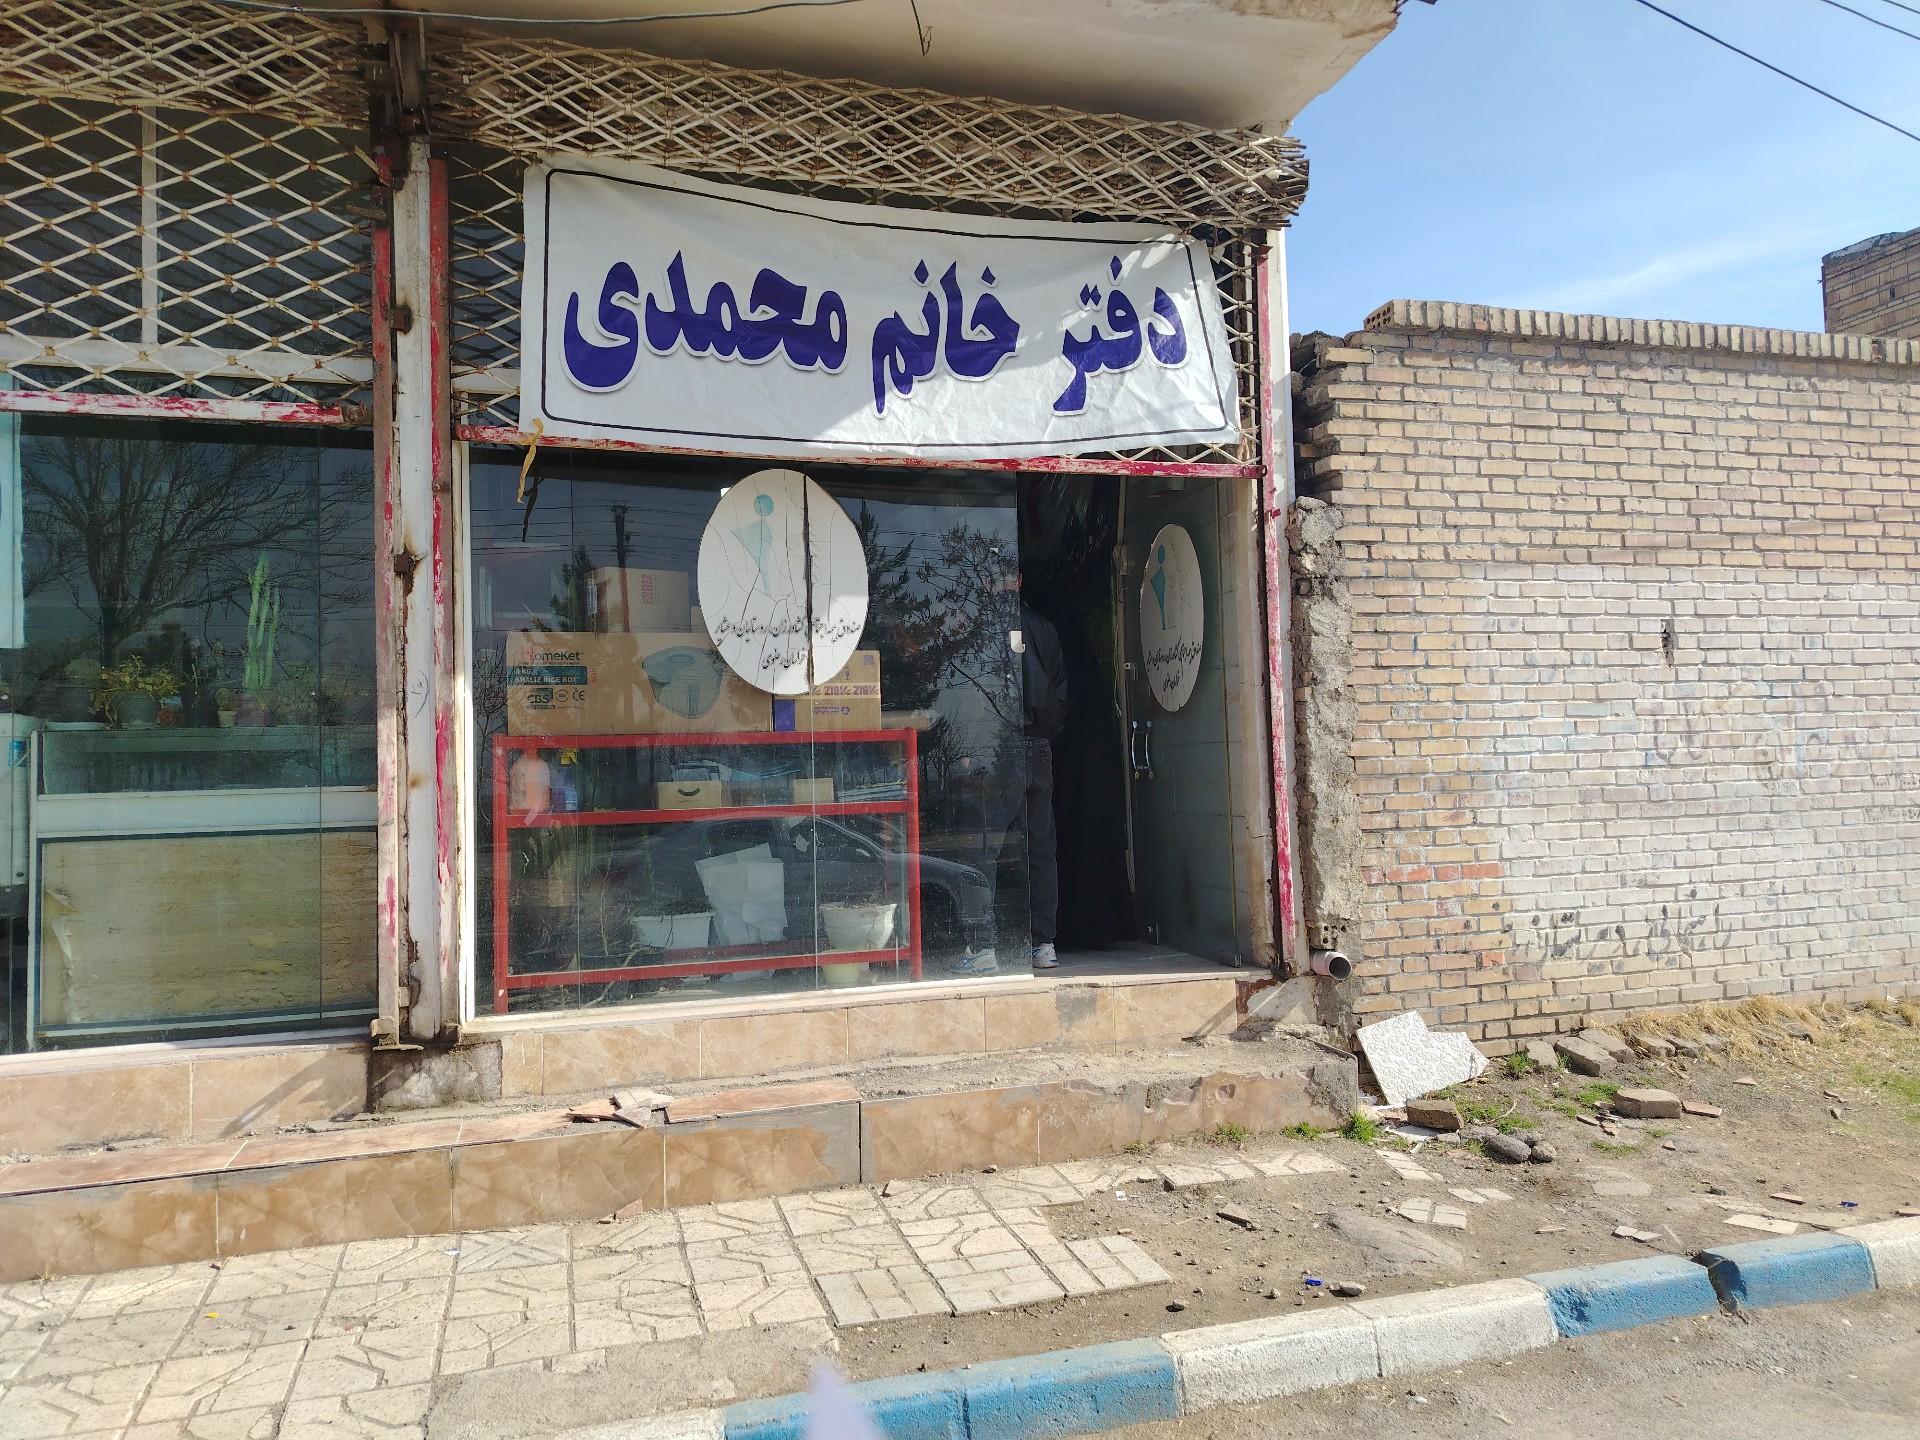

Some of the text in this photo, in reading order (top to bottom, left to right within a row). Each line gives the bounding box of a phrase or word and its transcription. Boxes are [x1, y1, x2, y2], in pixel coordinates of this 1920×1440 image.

[564, 250, 1187, 414] دفتر خانم محمدی
[762, 648, 781, 670] رضوی
